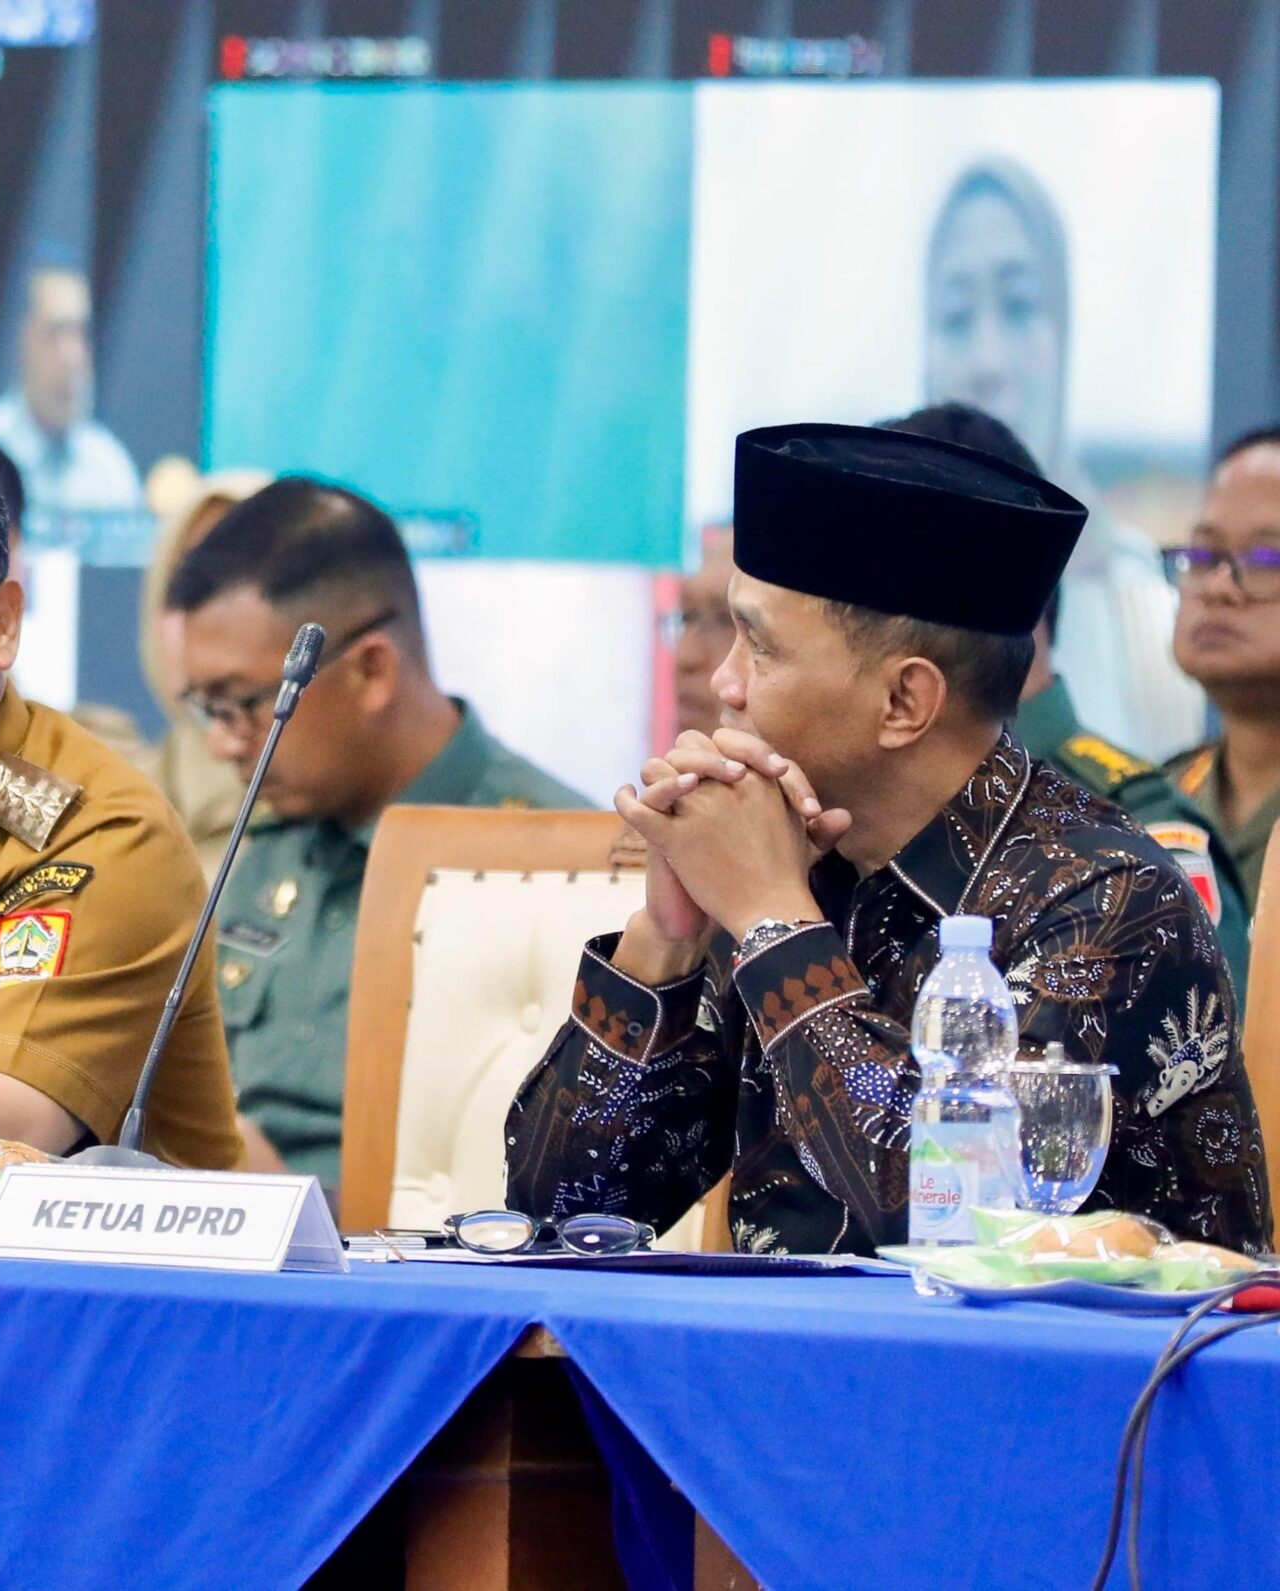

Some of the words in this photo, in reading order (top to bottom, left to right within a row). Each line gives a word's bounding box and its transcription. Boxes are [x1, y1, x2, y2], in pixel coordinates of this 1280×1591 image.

[920, 1173, 935, 1190] Le
[32, 1199, 144, 1233] KETUA
[154, 1205, 246, 1236] DPRD
